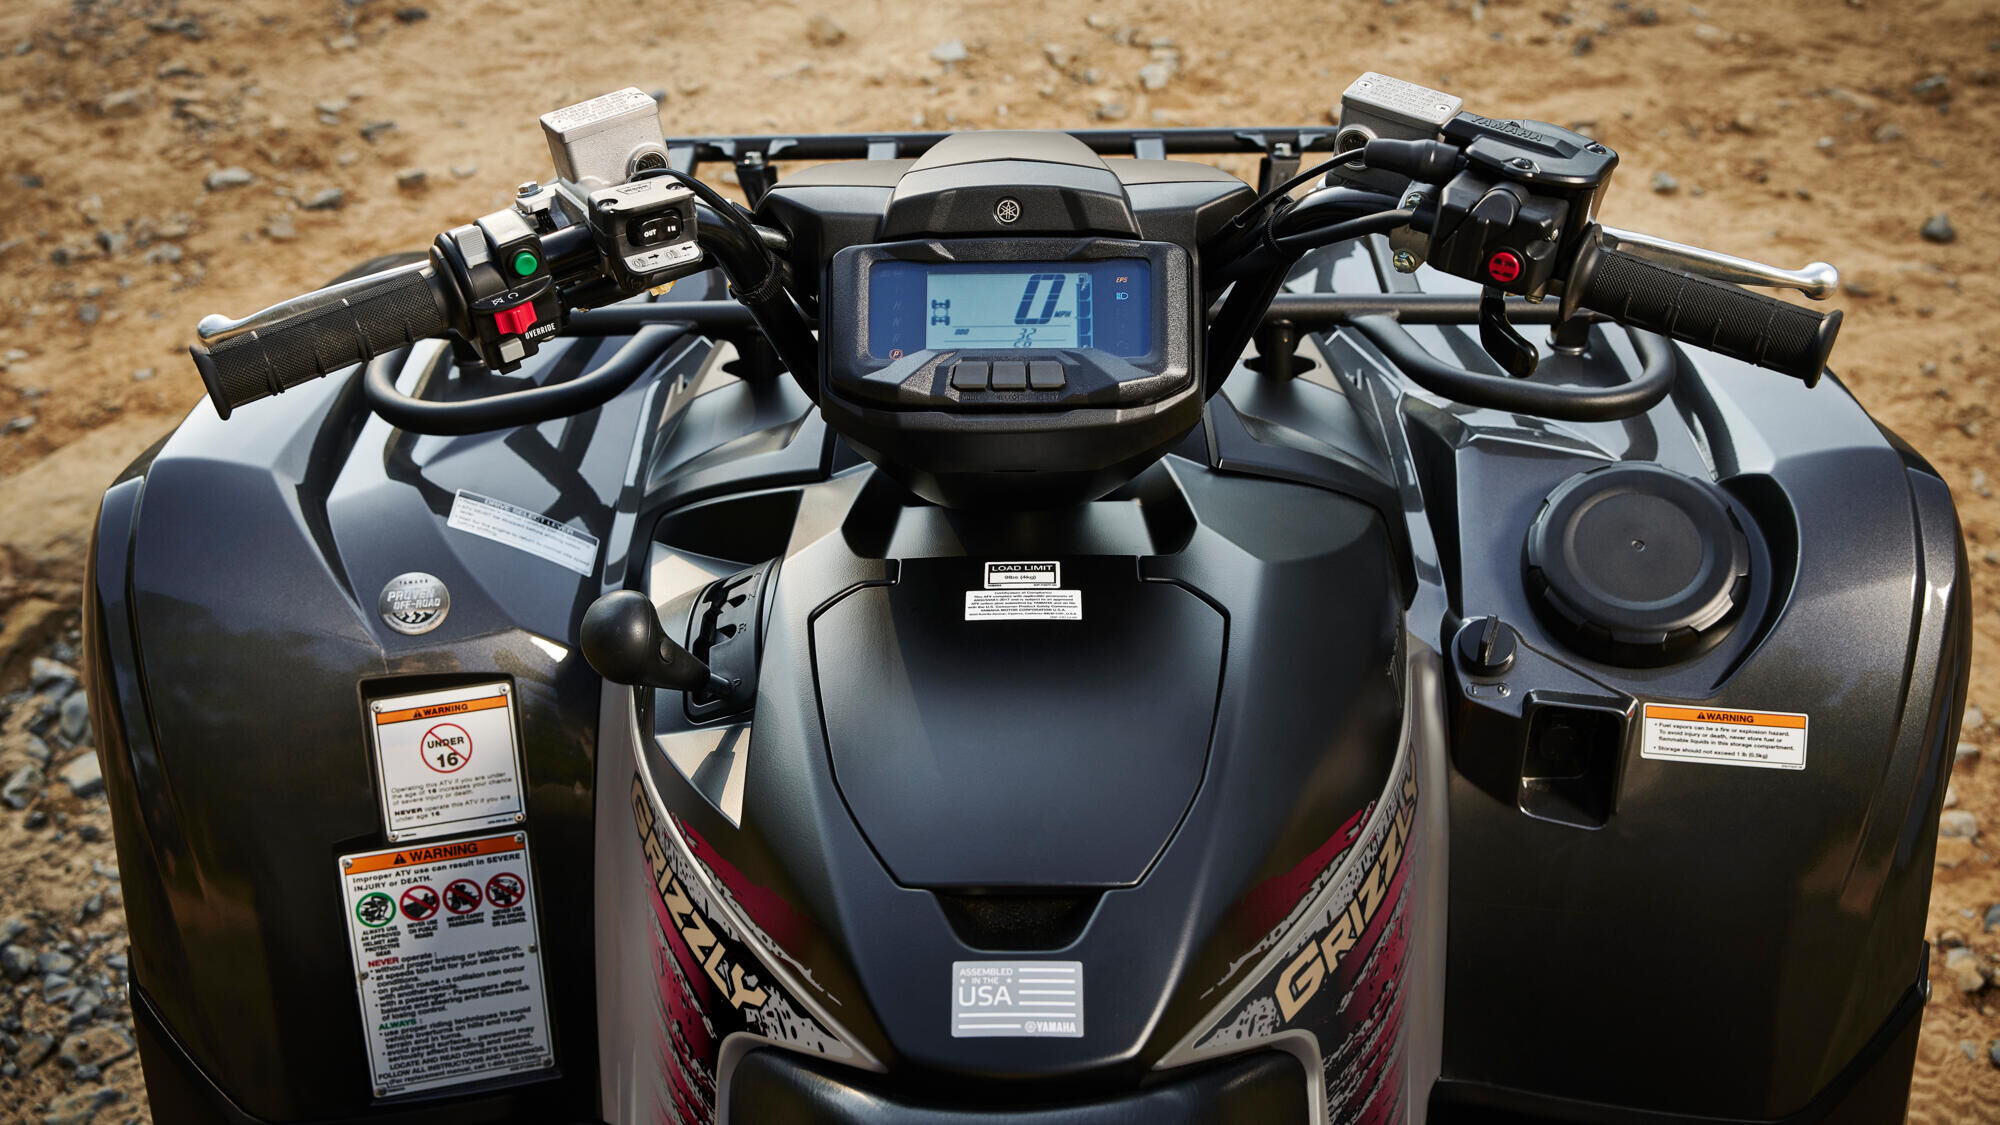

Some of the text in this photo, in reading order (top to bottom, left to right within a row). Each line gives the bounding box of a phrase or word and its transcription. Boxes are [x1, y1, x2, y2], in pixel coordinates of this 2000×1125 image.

[1472, 115, 1543, 141] YAMAHA
[644, 229, 656, 237] OUT
[1014, 274, 1065, 324] 0
[525, 323, 555, 339] OVERRIDE
[1020, 328, 1036, 339] 32
[387, 589, 435, 602] PROVEN
[393, 598, 440, 610] OFF-ROAD
[423, 703, 468, 715] WARNING
[1706, 712, 1753, 723] WARNING
[427, 736, 464, 748] UNDER
[436, 751, 458, 768] 16
[390, 783, 423, 794] Operating
[486, 771, 505, 779] under
[439, 783, 470, 793] increases
[472, 780, 486, 788] your
[488, 776, 511, 785] chance
[394, 807, 423, 816] NEVER
[424, 803, 449, 812] operate
[464, 798, 478, 806] ATV
[401, 796, 423, 804] severe
[425, 793, 443, 801] injury
[410, 843, 478, 862] WARNING
[352, 853, 520, 883] Improper ATV use can result in SEVERE
[353, 881, 385, 892] INJURY
[631, 774, 771, 1010] GRIZZLY
[1274, 747, 1418, 1023] GRIZZLY
[367, 951, 432, 968] NEVER operate
[374, 963, 404, 974] without
[406, 959, 433, 969] proper
[435, 954, 465, 964] training
[385, 969, 414, 979] speeds
[416, 966, 428, 974] too
[430, 964, 445, 972] fast
[460, 958, 477, 967] your
[480, 955, 499, 964] skills
[512, 951, 524, 959] the
[960, 968, 1013, 976] ASSEMBLED
[959, 986, 1012, 1006] USA
[378, 1018, 415, 1030] ALWAYS
[1037, 1022, 1076, 1032] YAMAHA
[389, 1059, 419, 1070] LOCATE
[421, 1056, 438, 1064] AND
[440, 1052, 460, 1061] READ
